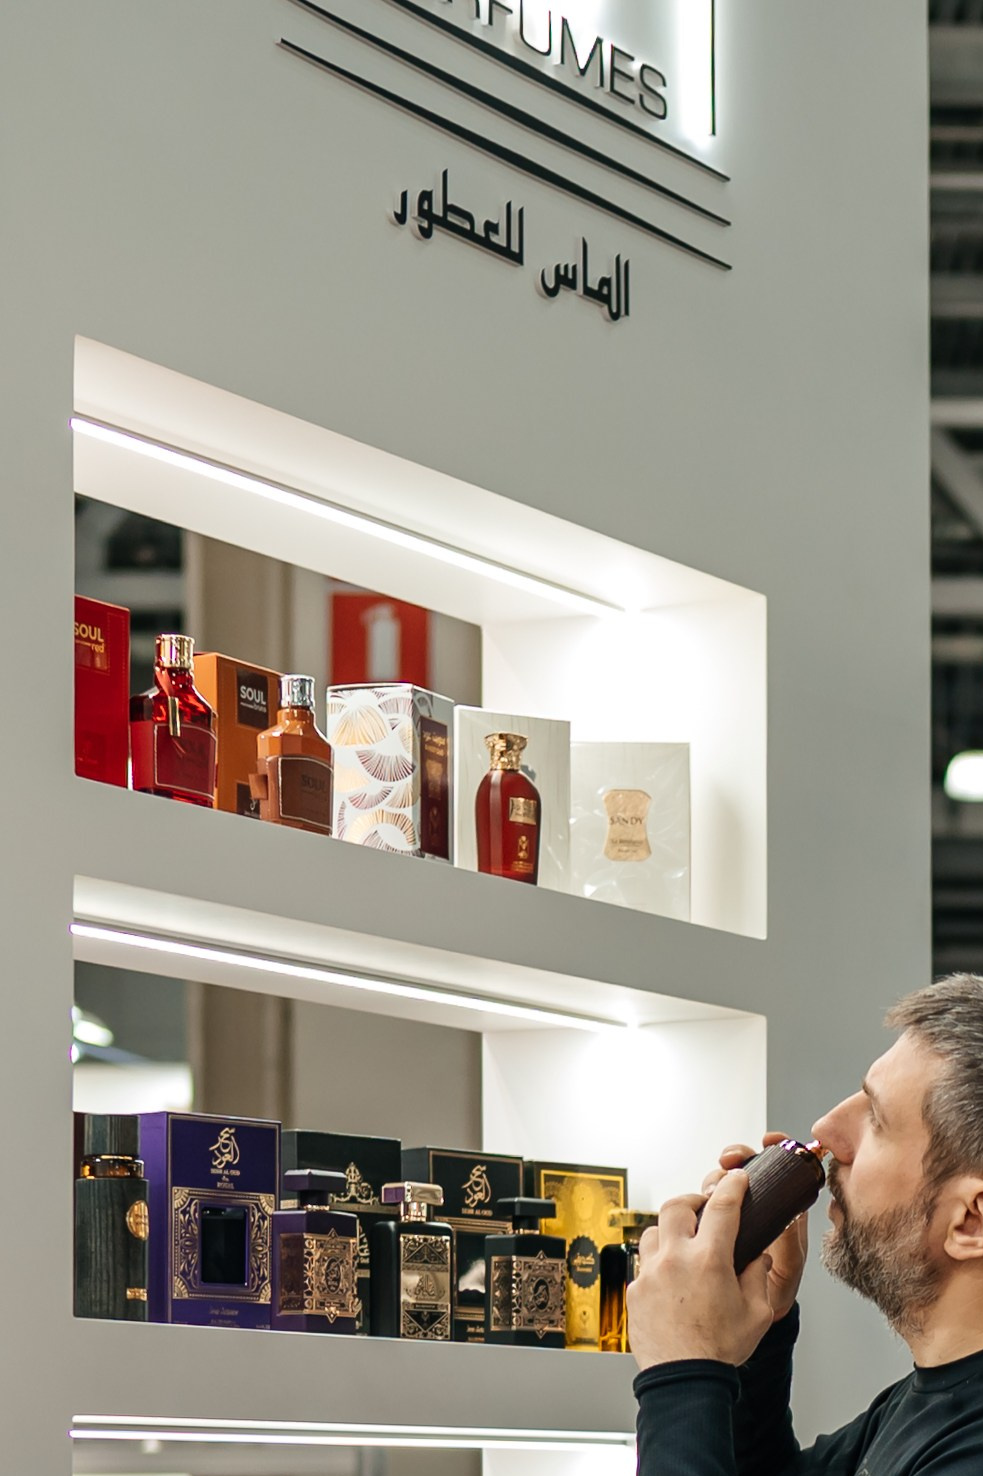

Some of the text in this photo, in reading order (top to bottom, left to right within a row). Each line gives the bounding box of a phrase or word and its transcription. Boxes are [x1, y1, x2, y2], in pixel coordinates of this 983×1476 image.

[393, 168, 629, 321] الماس للعطور
[74, 621, 105, 643] SOUL
[239, 684, 267, 705] SOUL
